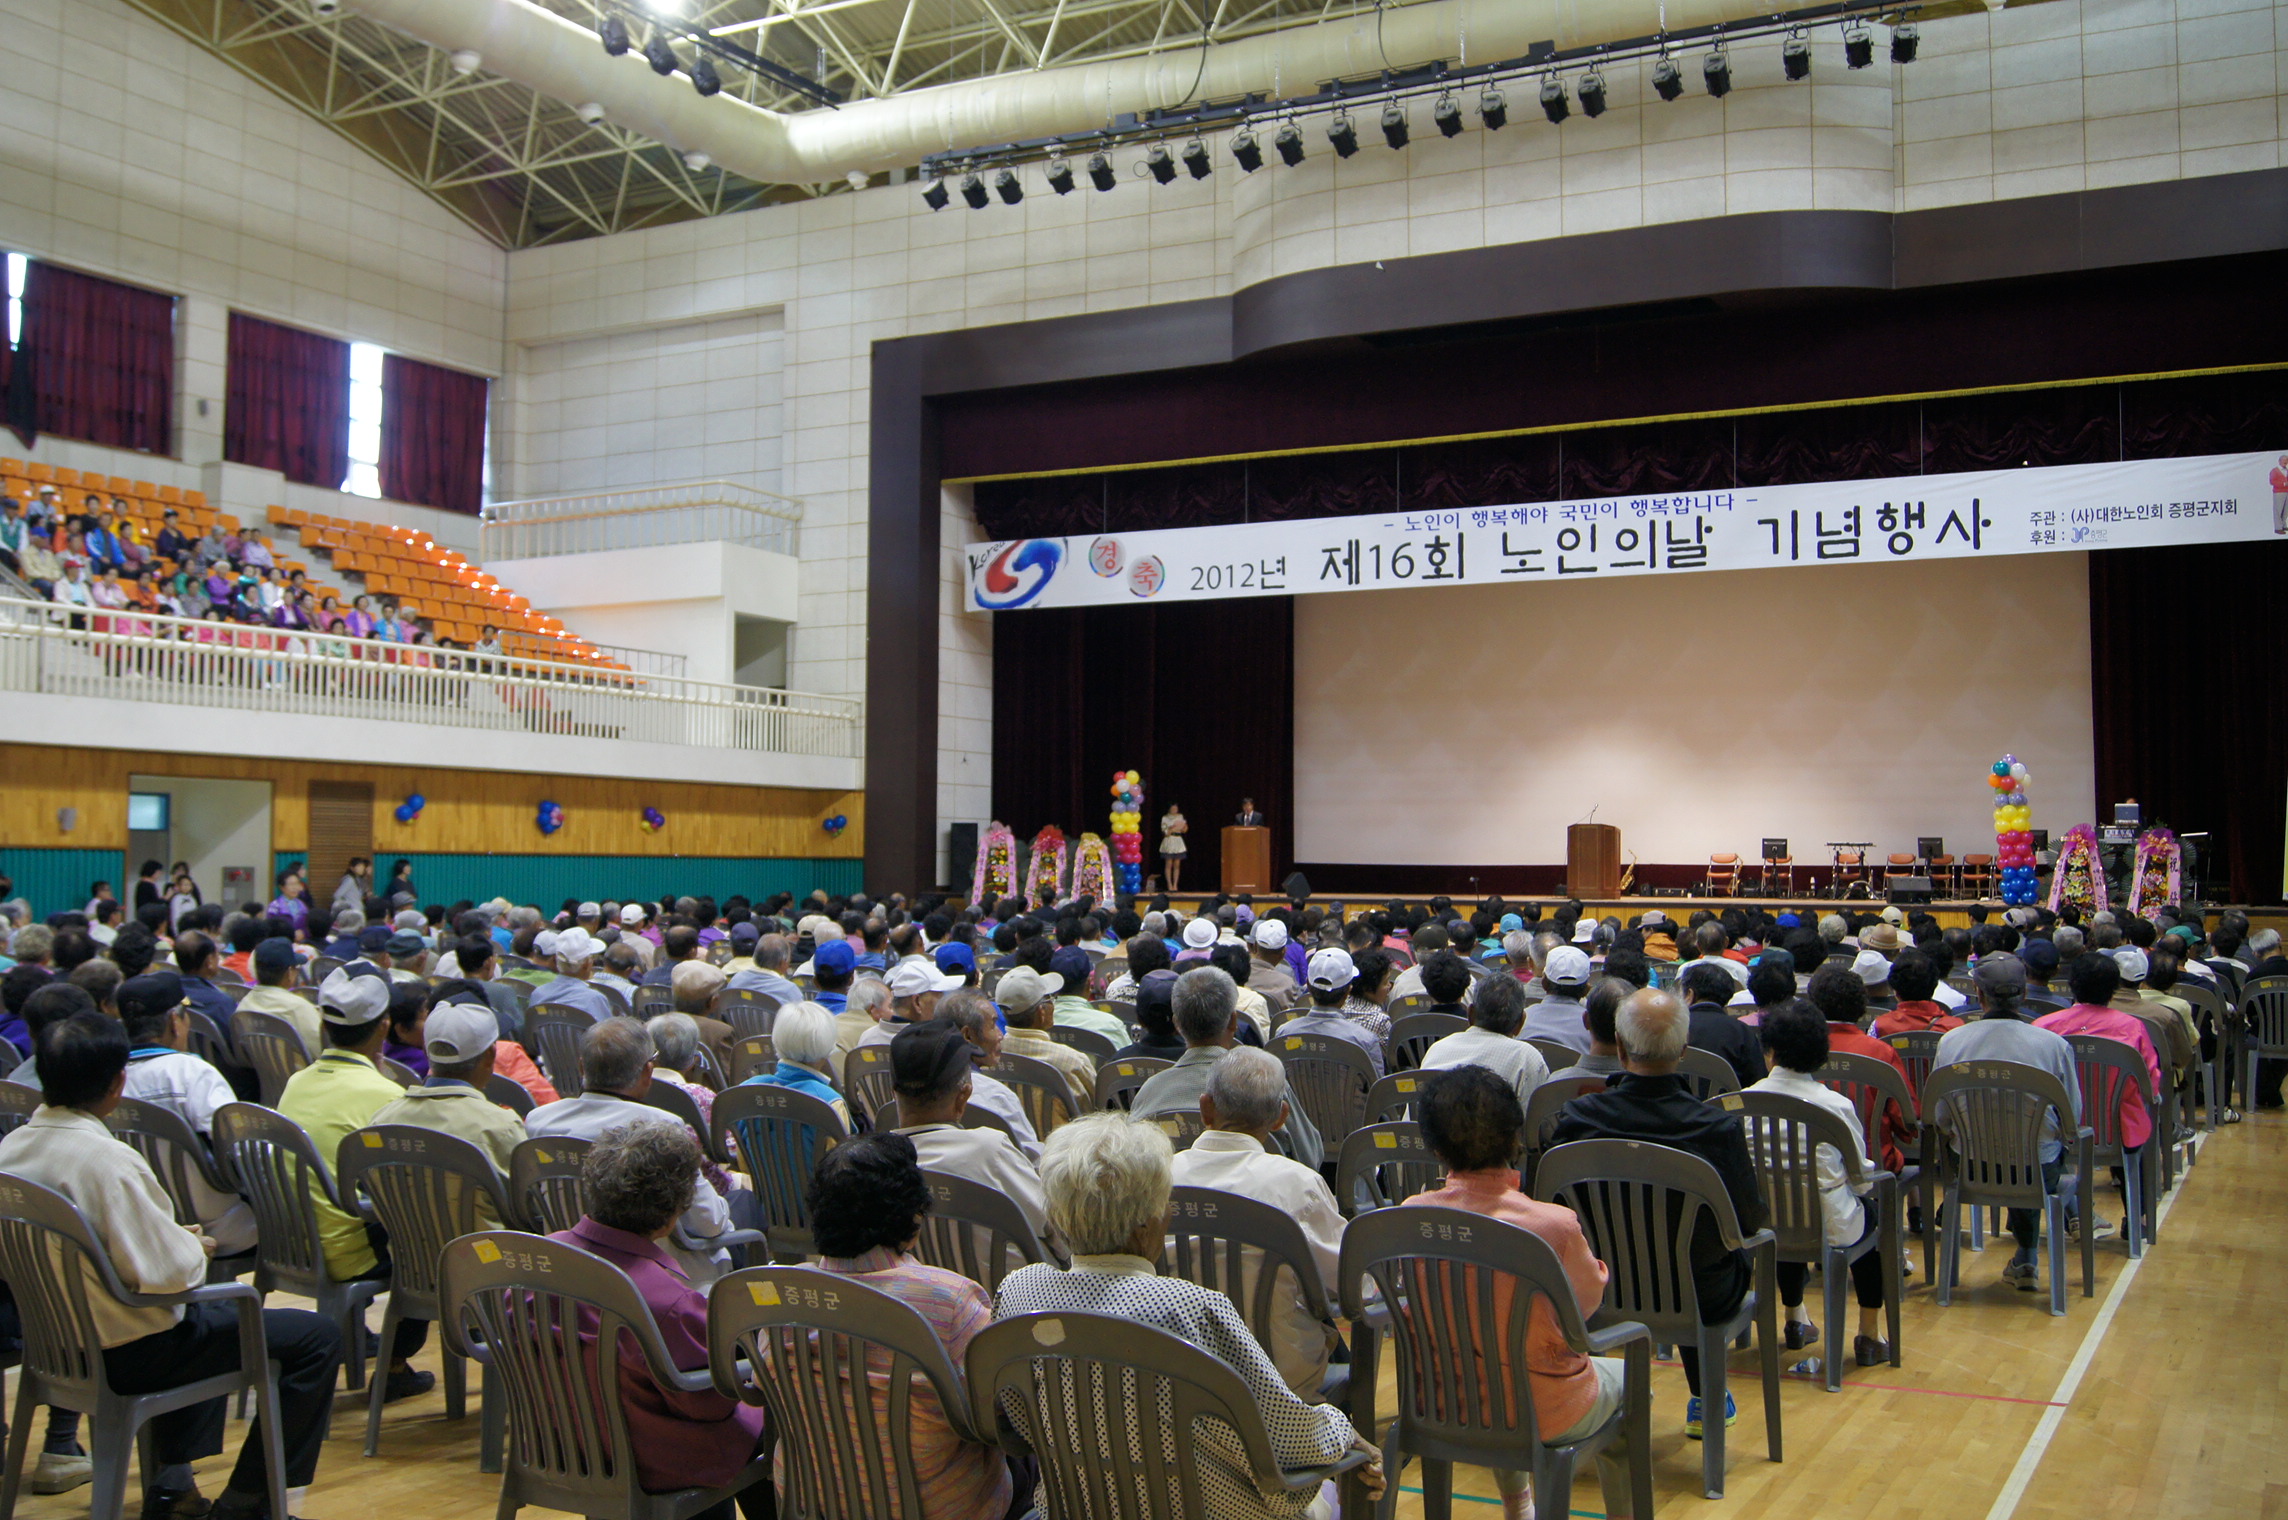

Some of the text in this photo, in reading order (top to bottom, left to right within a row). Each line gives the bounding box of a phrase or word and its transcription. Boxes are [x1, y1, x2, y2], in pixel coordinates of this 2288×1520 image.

[1404, 512, 1461, 532] 노인이
[1471, 506, 1549, 528] 행복해야
[1559, 501, 1618, 522] 국민이
[1630, 493, 1735, 518] 행복합니다
[2029, 511, 2056, 527] 주관
[2070, 503, 2163, 525] (사)대한노인회
[2168, 498, 2238, 519] 증평군지회
[1189, 497, 1992, 591] 2012년 제16회 노인의날 기념행사
[2029, 530, 2056, 546] 후원
[1097, 541, 1158, 591] 경 축
[388, 1137, 427, 1153] 증평군
[1420, 1221, 1473, 1243] 증평군
[502, 1250, 552, 1273] 증평군
[783, 1285, 841, 1311] 증평군
